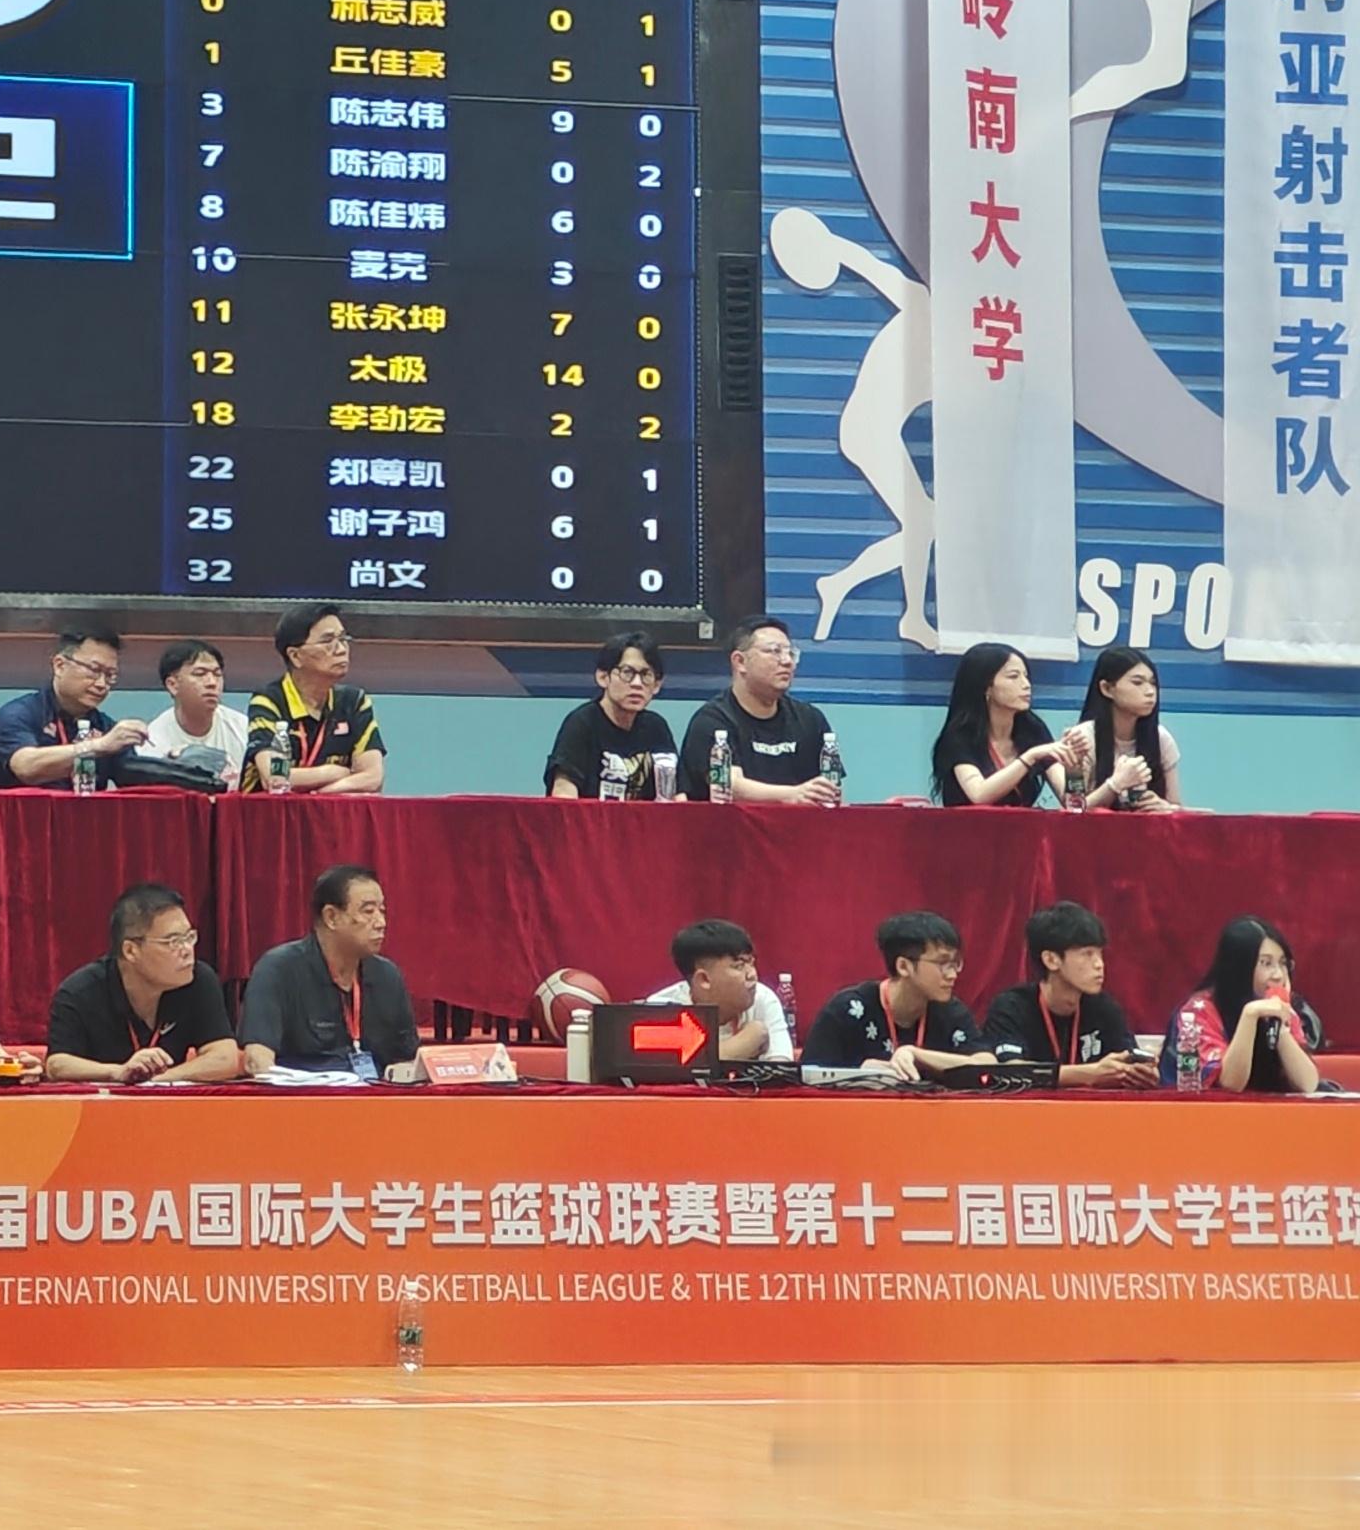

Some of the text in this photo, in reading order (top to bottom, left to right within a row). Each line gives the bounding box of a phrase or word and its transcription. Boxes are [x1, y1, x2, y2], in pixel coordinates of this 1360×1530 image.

[551, 10, 571, 31] 0
[641, 15, 653, 35] 1
[206, 43, 654, 85] 1 丘佳豪 5 1
[202, 93, 661, 137] 3 陈志伟 9 0
[201, 145, 661, 187] 7 陈渝翔 0 2
[200, 195, 662, 237] 8 陈佳炜 6 0
[192, 247, 572, 285] 10 麦克 3
[193, 300, 660, 339] 11 张永坤 7 0
[193, 352, 584, 386] 12 太极 14
[193, 402, 660, 438] 18 李劲宏 2 2
[189, 456, 656, 491] 22 郑尊凯 0 1
[188, 507, 657, 540] 25 谢子鸿 6 1
[189, 560, 573, 589] 32 尚文 0
[206, 1275, 369, 1303] UNIVERSITY
[378, 1274, 552, 1302] BASKETBALL
[559, 1274, 664, 1301] LEAGUE
[671, 1274, 691, 1301] &
[696, 1273, 751, 1301] THE
[759, 1274, 825, 1301] 12TH
[834, 1274, 1046, 1300] INTERNATIONAL
[1052, 1274, 1198, 1300] UNIVERSITY
[1204, 1274, 1360, 1300] BASKETBALL
